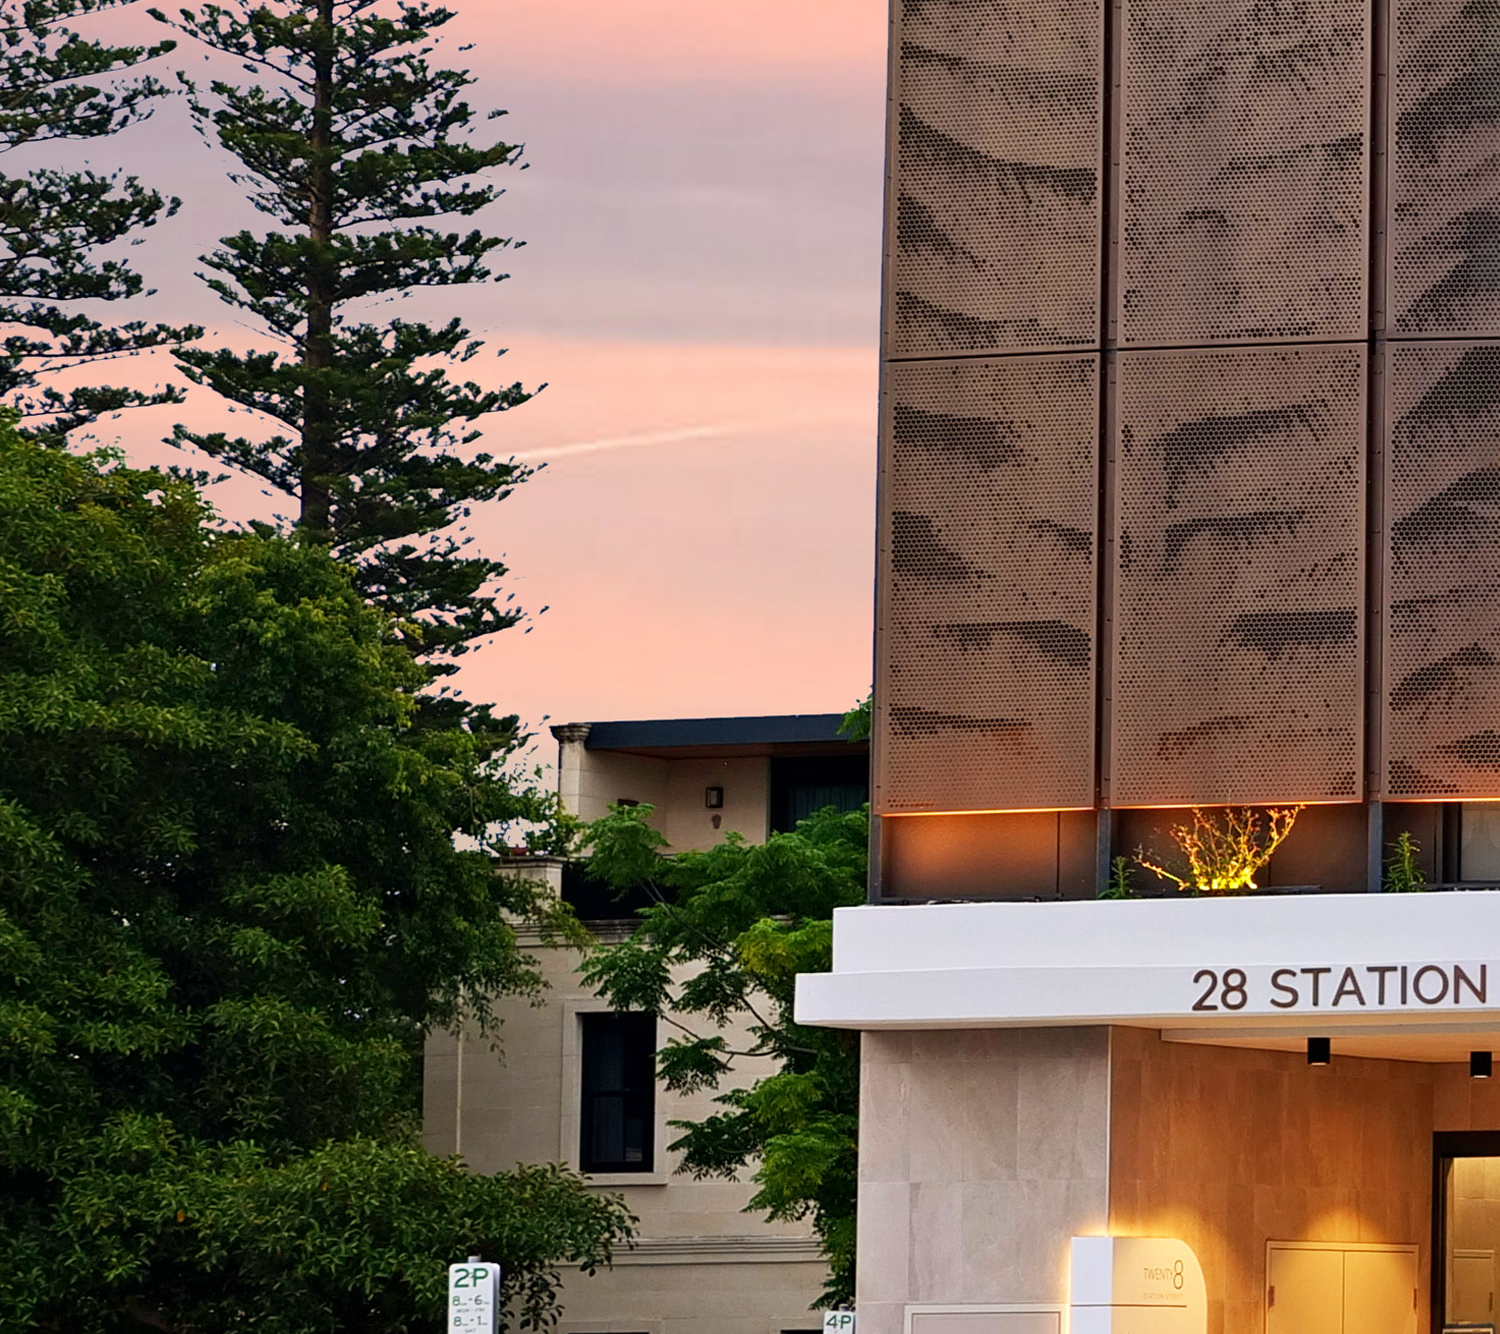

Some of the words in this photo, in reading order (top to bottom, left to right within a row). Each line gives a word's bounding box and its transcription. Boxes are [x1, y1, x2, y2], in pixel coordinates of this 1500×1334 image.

[1191, 968, 1249, 1012] 28
[1270, 964, 1487, 1008] STATION
[454, 1268, 489, 1288] 2P
[825, 1314, 852, 1329] 4P
